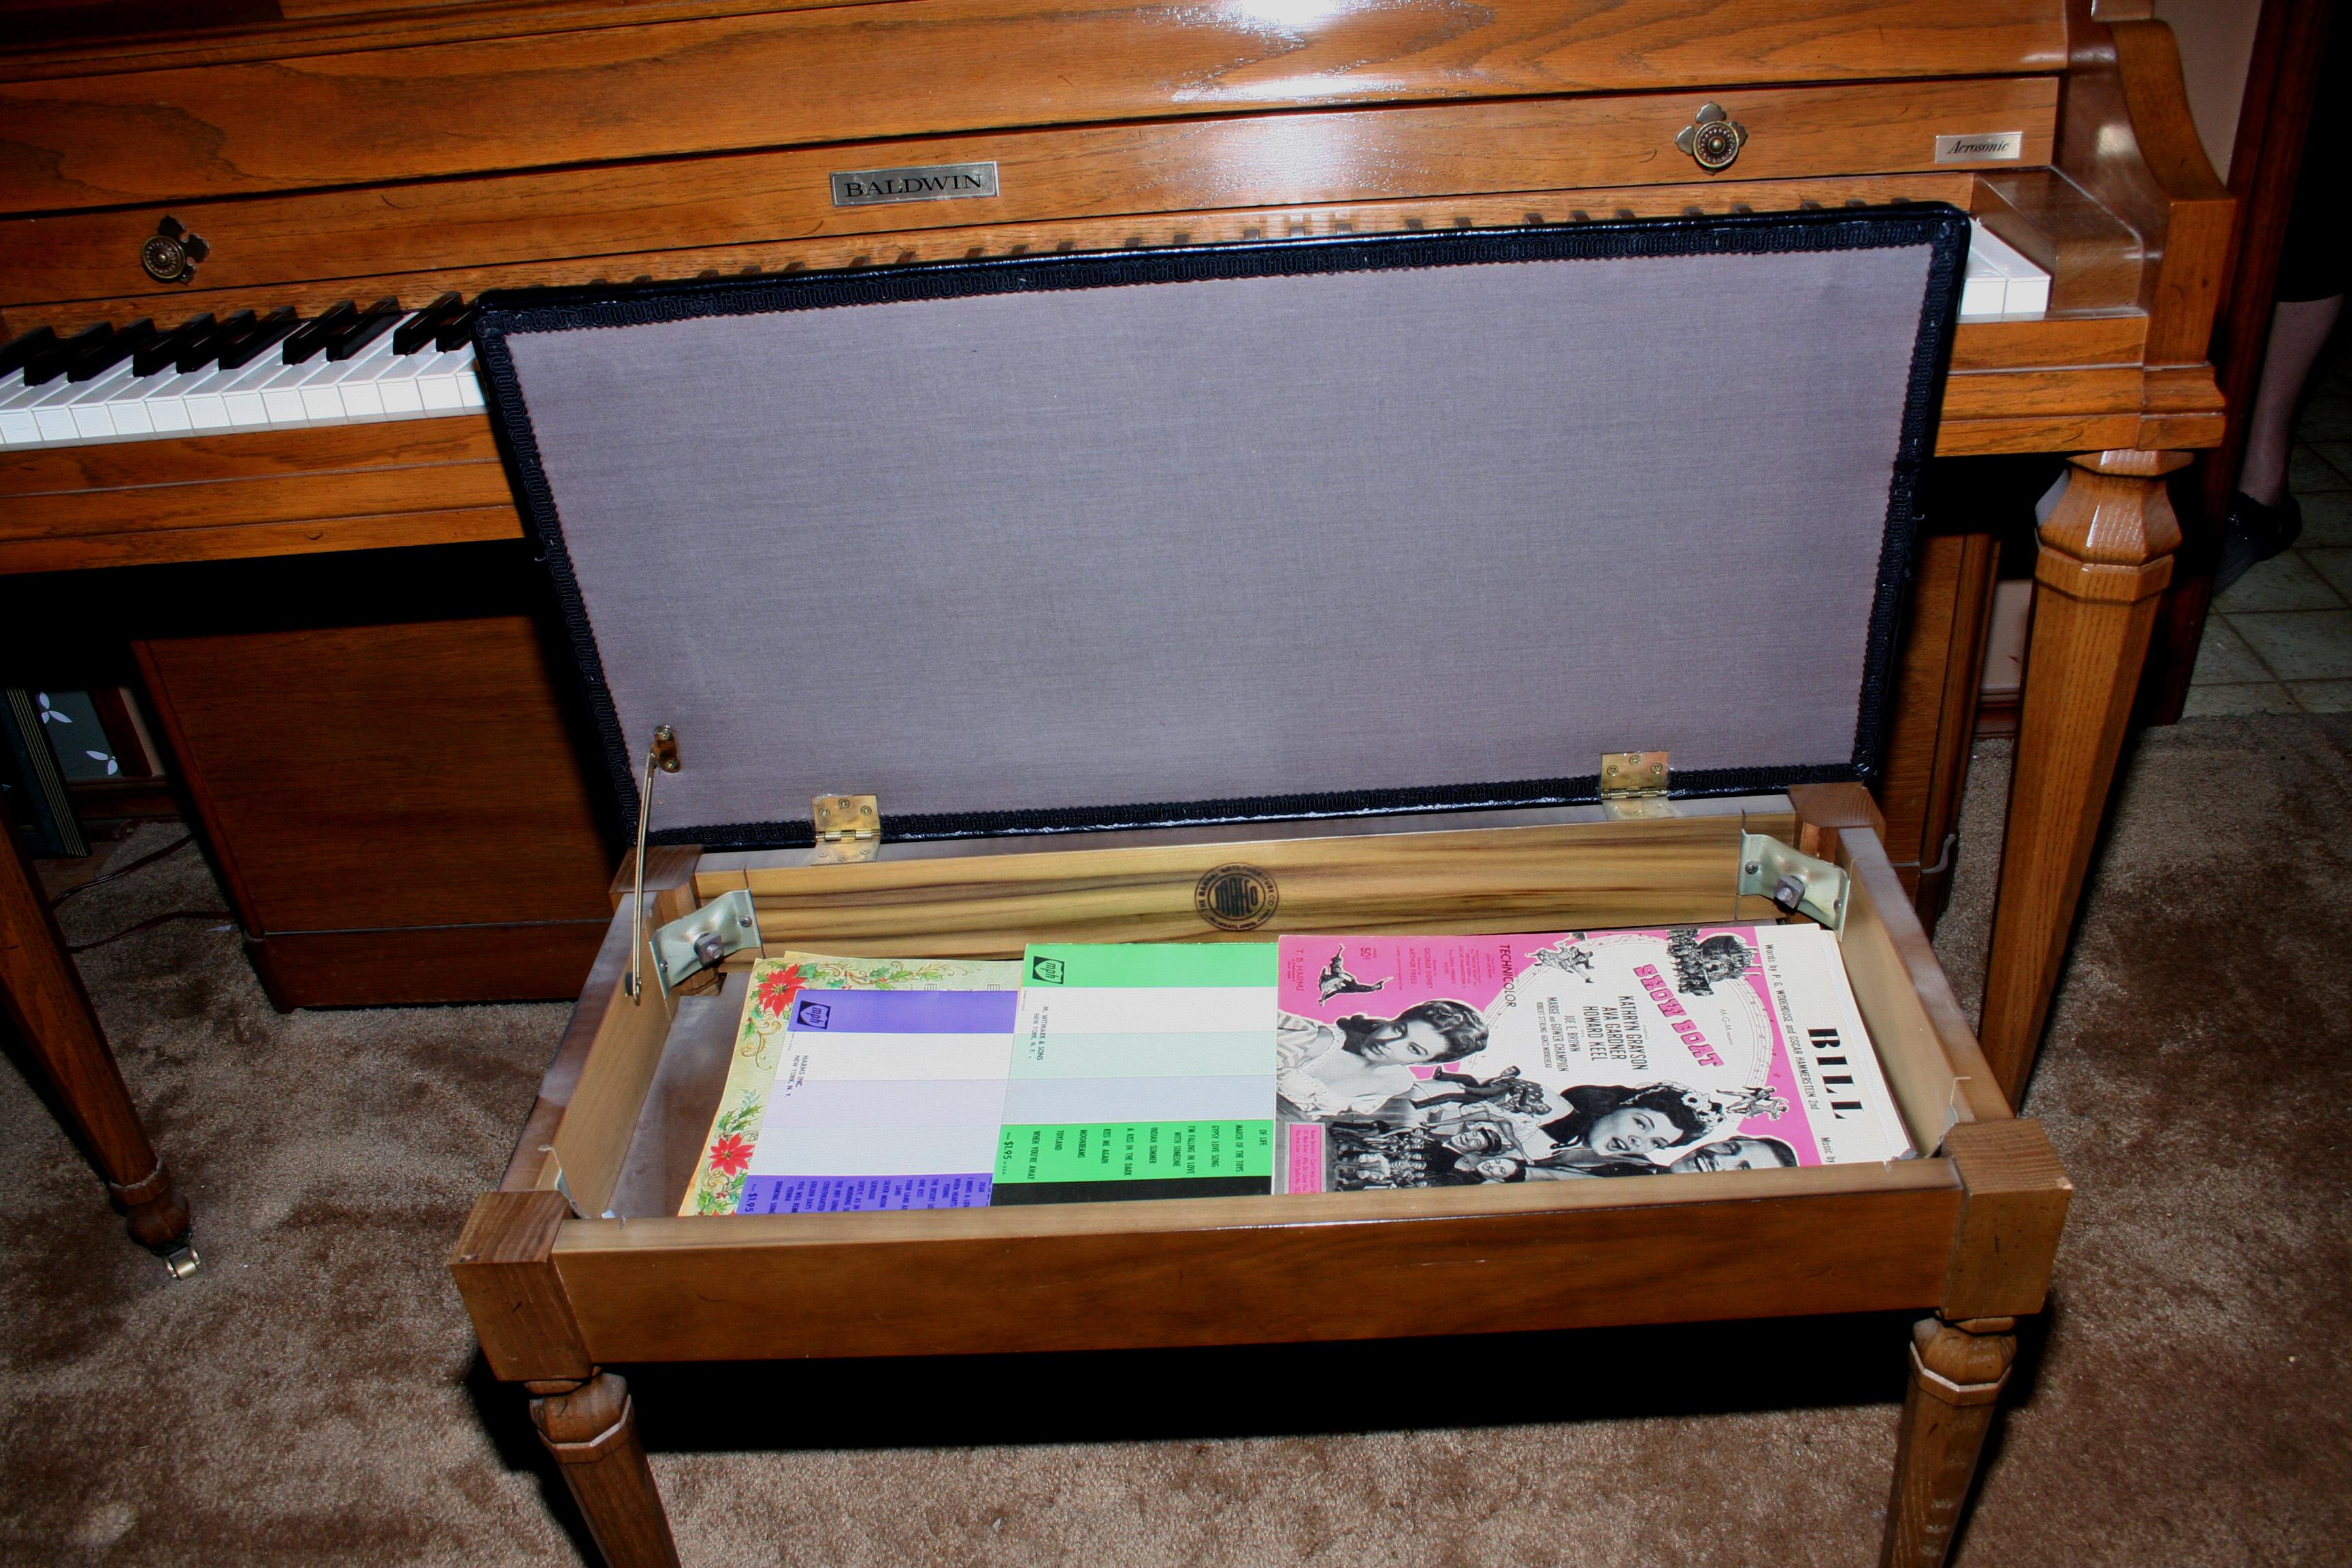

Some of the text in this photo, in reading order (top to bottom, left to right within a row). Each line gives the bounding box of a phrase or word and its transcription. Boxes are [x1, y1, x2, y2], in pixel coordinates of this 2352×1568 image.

[1947, 140, 2010, 154] Acrosonic
[844, 174, 982, 197] BALDWIN
[1765, 944, 1780, 962] Words
[1041, 962, 1059, 978] mph
[1499, 945, 1516, 1007] TECHNICOLOR
[806, 1007, 823, 1024] mph
[1546, 997, 1560, 1015] MARGE
[1633, 964, 1724, 1066] SHOW BOAT
[1776, 990, 1793, 1022] WODEHOUSE
[1039, 1015, 1048, 1039] WITMARK
[1538, 1016, 1548, 1033] STERLING
[1565, 1015, 1576, 1024] JOE
[1786, 1024, 1797, 1034] and
[1541, 1035, 1550, 1046] AGNES
[1551, 1024, 1564, 1041] GOWER
[1567, 1032, 1581, 1051] BROWN
[1582, 1006, 1607, 1061] HOWARD KEEL
[1602, 1007, 1627, 1060] AVA GARDNER
[1618, 996, 1649, 1070] KATHRYN GRAYSON
[1789, 1036, 1805, 1054] OSCAR
[799, 1055, 809, 1075] HARMS
[1554, 1043, 1569, 1072] CHAMPION
[1797, 1057, 1817, 1097] HAMMERSTEIN
[1807, 1026, 1864, 1120] BILL
[1808, 1100, 1820, 1110] 2nd
[1055, 1130, 1064, 1151] TOYLAND
[1211, 1126, 1220, 1139] GYPSY
[1003, 1141, 1014, 1160] $1.95
[1078, 1130, 1088, 1158] MOONBEAMS
[1149, 1127, 1158, 1164] INDIAN SUMMER
[1820, 1137, 1832, 1154] Music
[1027, 1131, 1041, 1179] WHEN YOU'RE AWAY
[1101, 1149, 1109, 1164] AGAIN
[1173, 1145, 1181, 1166] SOMEONE
[1124, 1163, 1132, 1176] DARK
[1187, 1162, 1195, 1174] LOVE
[855, 1181, 866, 1196] SOFTLY,
[868, 1180, 878, 1200] SERENADE
[918, 1179, 926, 1187] ONE
[942, 1183, 950, 1198] YOUNG
[950, 1178, 961, 1207] WHEN HEARTS
[745, 1193, 758, 1211] $1.95
[768, 1181, 783, 1213] DRINKING SONG
[785, 1187, 794, 1201] VIENNA
[794, 1192, 802, 1201] WILL
[805, 1181, 818, 1209] GOLDEN DAYS
[845, 1186, 855, 1205] MORNING
[879, 1180, 891, 1208] SILVER MOON
[929, 1188, 937, 1201] DESERT
